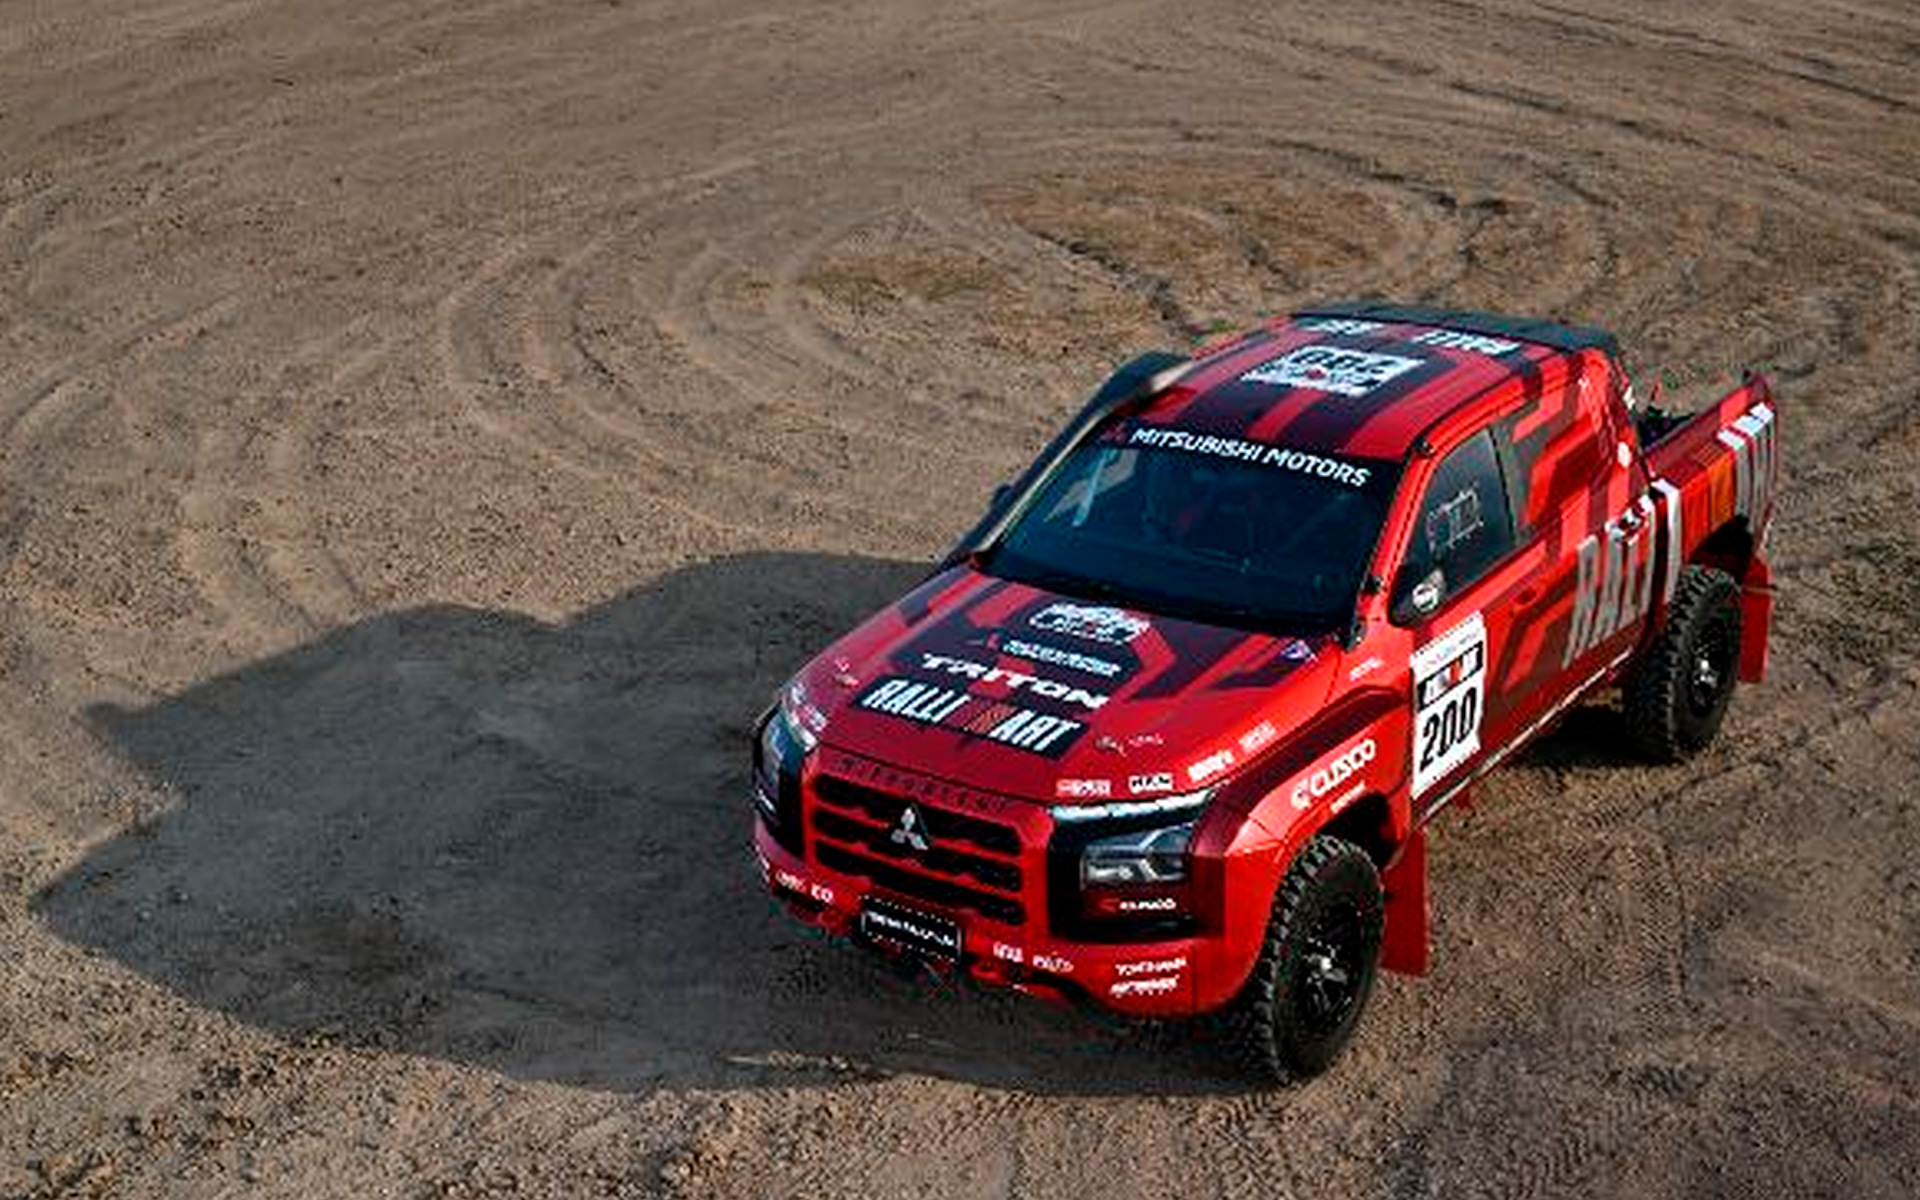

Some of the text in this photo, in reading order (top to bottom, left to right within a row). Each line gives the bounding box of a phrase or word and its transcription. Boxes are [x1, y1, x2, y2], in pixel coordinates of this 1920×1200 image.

[1129, 428, 1372, 487] MITSUBISHI MOTORS
[922, 653, 1110, 709] TRITON
[1419, 687, 1477, 772] 200
[1310, 738, 1375, 797] CUSCO
